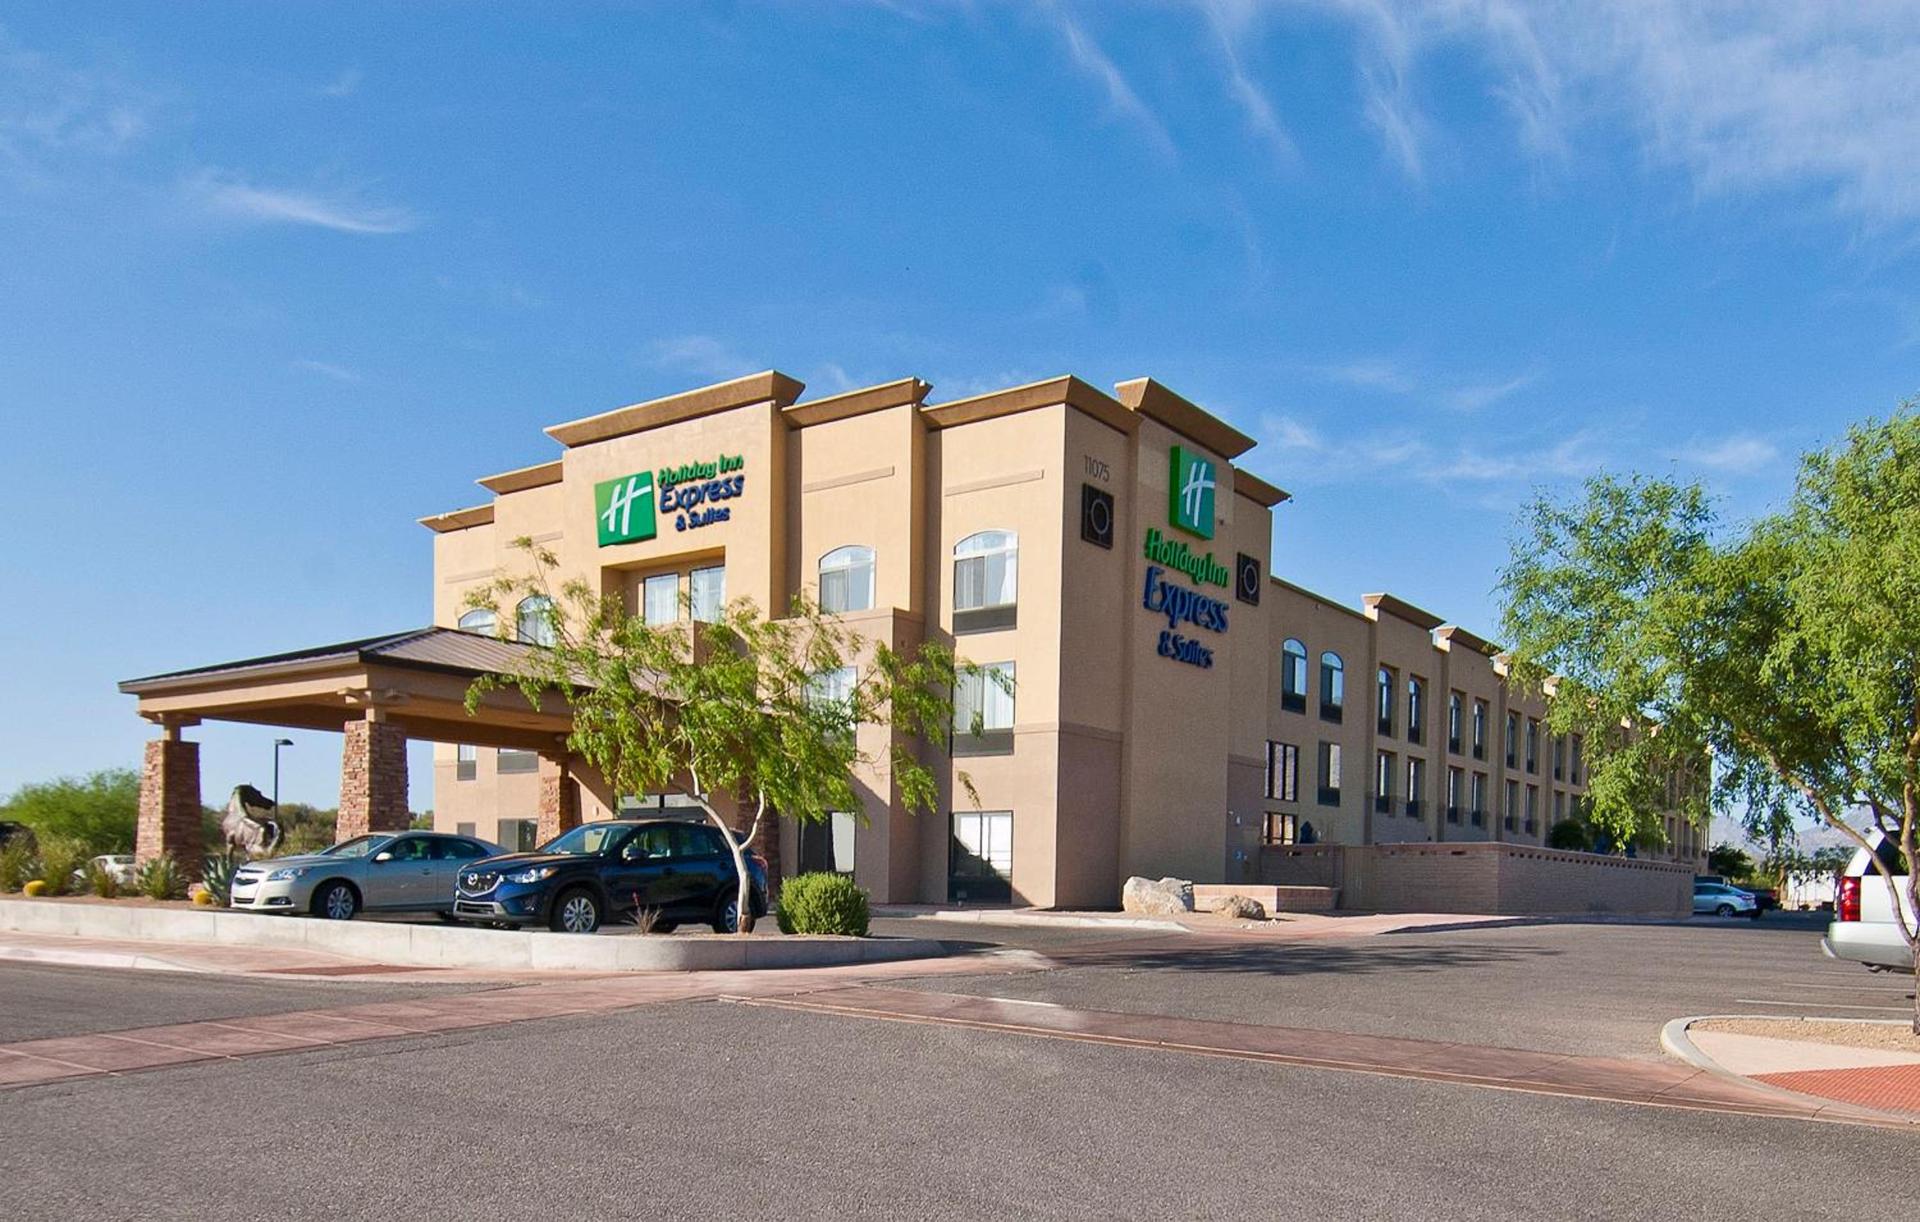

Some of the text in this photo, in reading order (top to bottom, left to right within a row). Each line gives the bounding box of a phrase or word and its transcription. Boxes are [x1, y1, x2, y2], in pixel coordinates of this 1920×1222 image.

[657, 454, 744, 487] Holiday Inn
[1084, 454, 1110, 482] 11075
[659, 474, 745, 513] Express
[675, 506, 731, 532] & Suites
[1144, 527, 1230, 589] Holiday Inn
[1143, 565, 1230, 634] Express
[1157, 630, 1214, 669] & Suites
